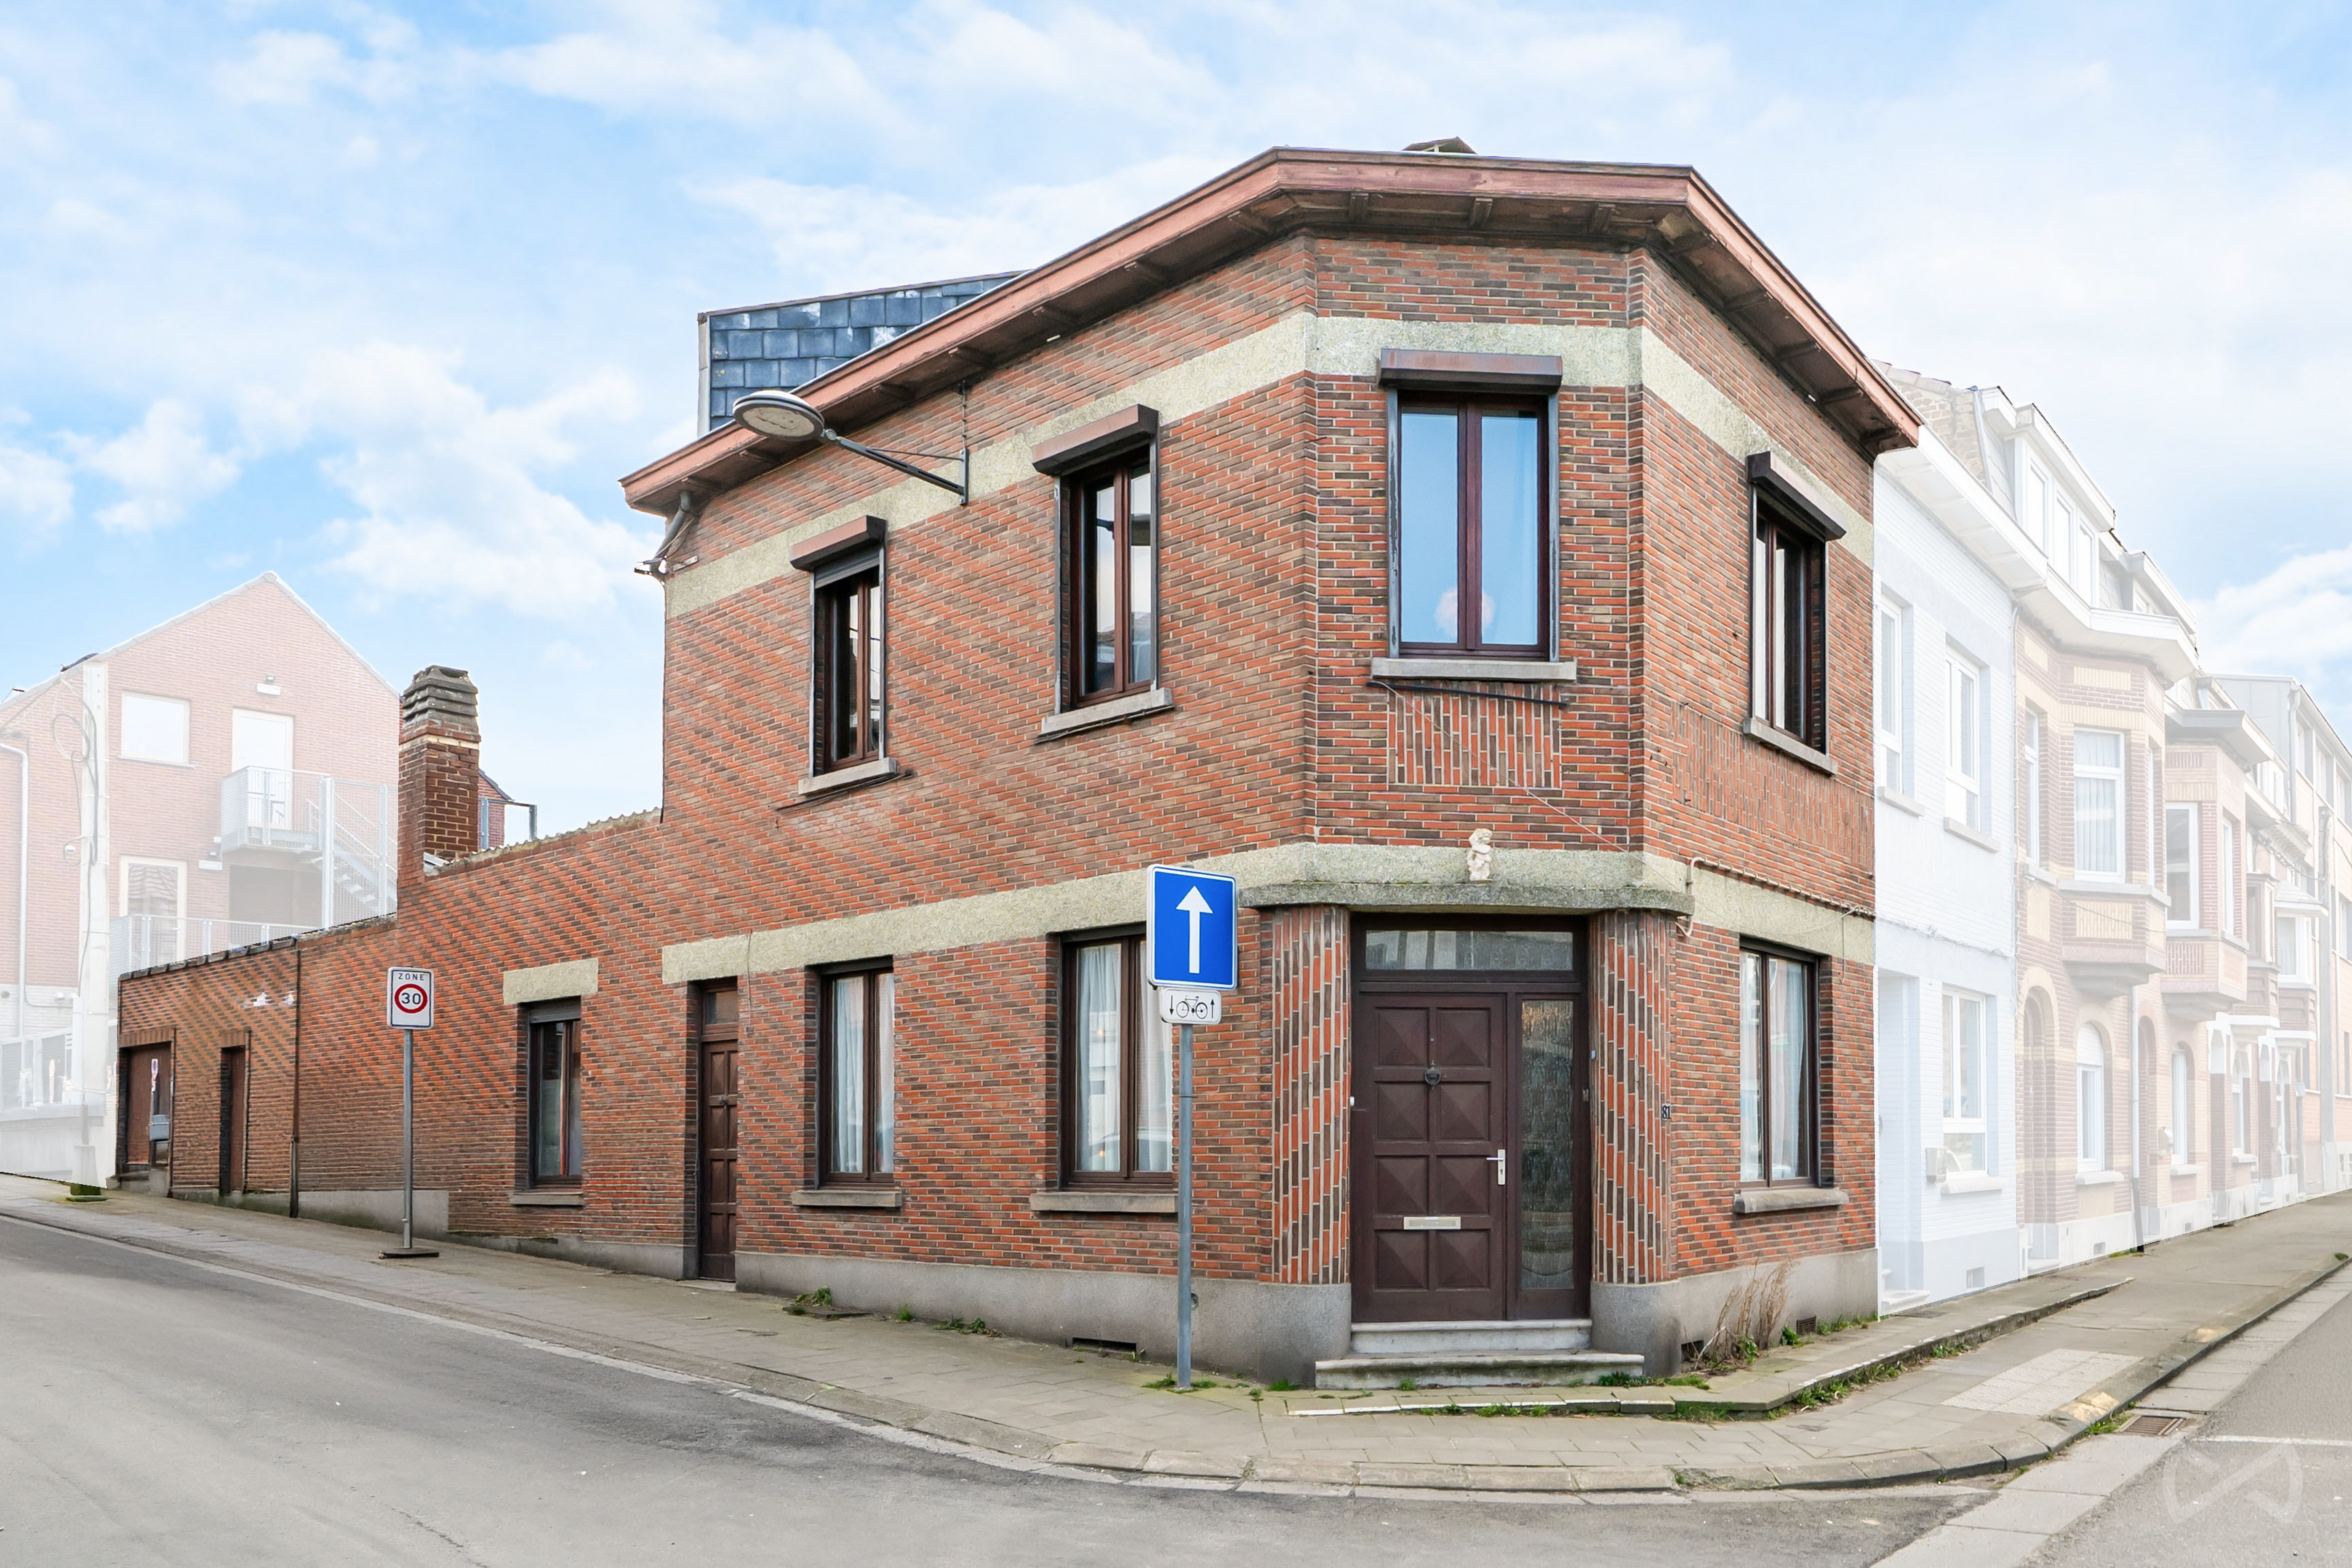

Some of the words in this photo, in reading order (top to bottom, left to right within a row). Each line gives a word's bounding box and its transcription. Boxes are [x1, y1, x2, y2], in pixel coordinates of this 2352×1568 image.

[398, 973, 425, 981] ZONE
[401, 992, 421, 1004] 30
[1662, 1105, 1671, 1120] 81
